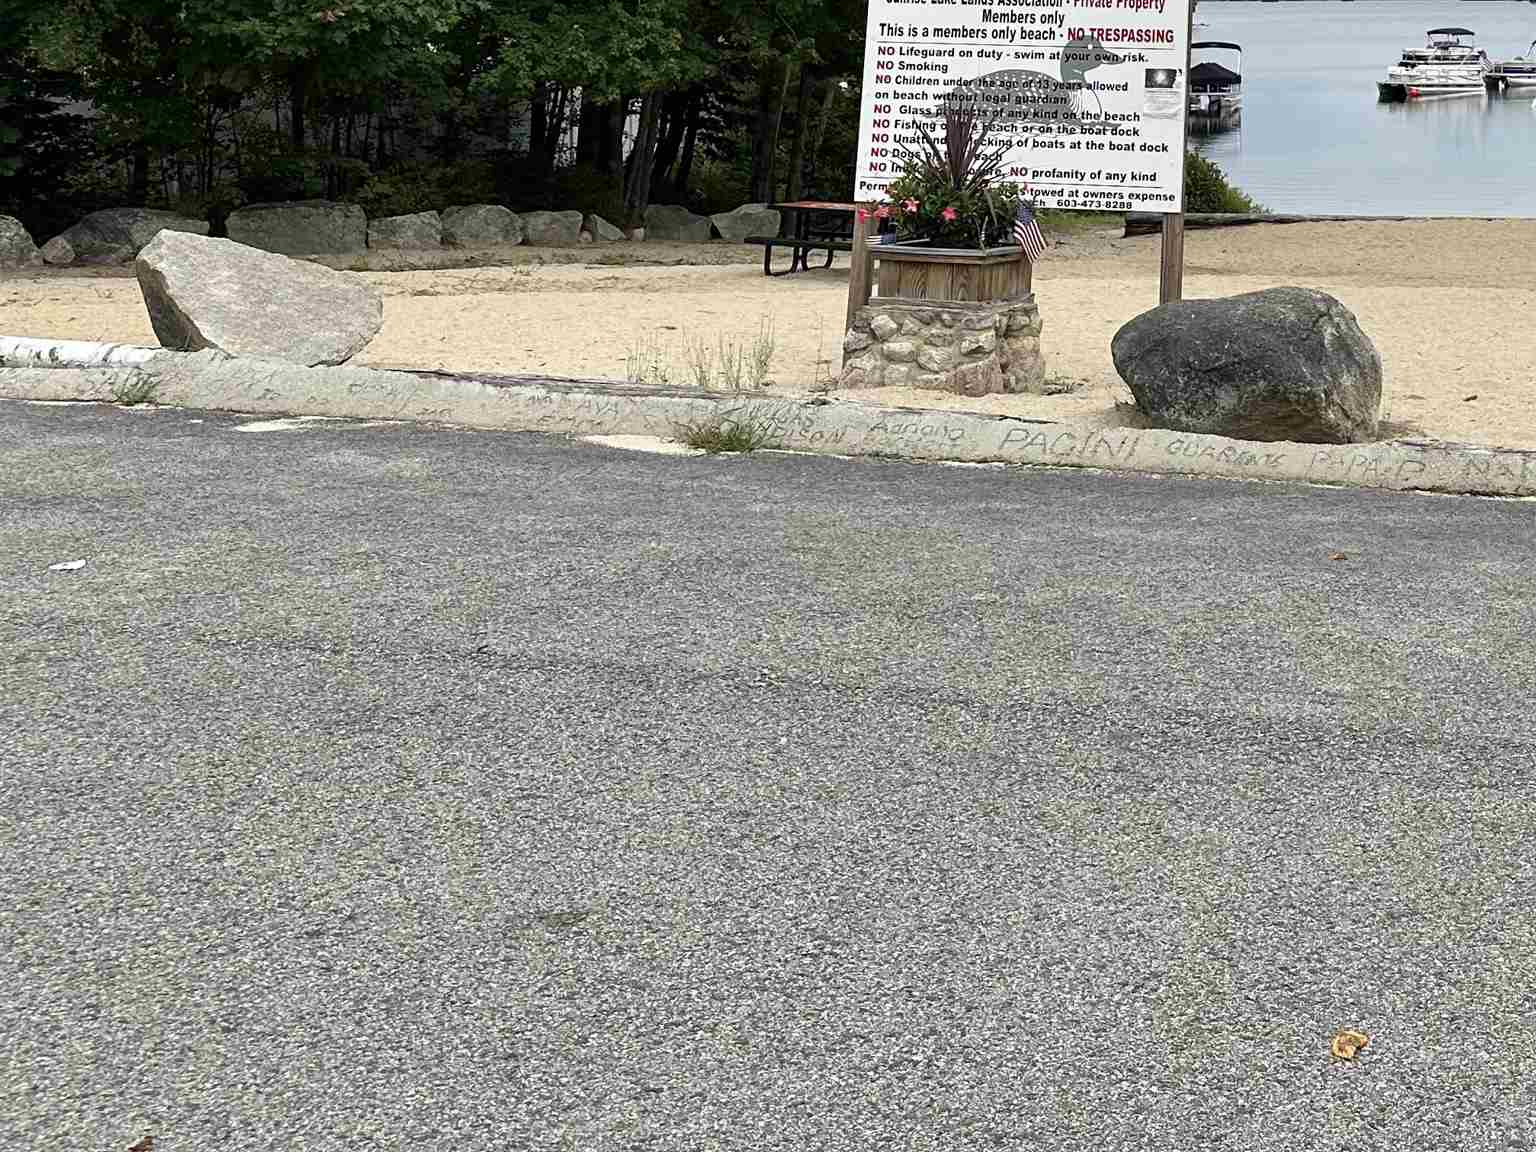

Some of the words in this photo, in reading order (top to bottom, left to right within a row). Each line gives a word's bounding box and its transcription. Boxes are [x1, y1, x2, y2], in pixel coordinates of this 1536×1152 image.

[982, 9, 1036, 24] Members
[1040, 10, 1065, 29] only
[879, 23, 904, 37] This
[908, 24, 918, 37] is
[922, 27, 929, 37] a
[933, 25, 988, 39] members
[991, 26, 1017, 43] only
[1020, 27, 1056, 42] beach
[1067, 28, 1085, 42] NO
[1089, 28, 1175, 44] TRESPASSING
[878, 46, 895, 56] NO
[899, 47, 955, 59] Lifeguard
[958, 50, 973, 58] on
[977, 49, 1003, 60] duty
[1014, 51, 1045, 61] swim
[1049, 51, 1060, 60] at
[1064, 53, 1091, 63] your
[1094, 53, 1119, 61] own
[876, 60, 894, 70] NO
[897, 61, 949, 74] Smoking
[875, 75, 891, 84] NO
[895, 75, 939, 86] Children
[943, 77, 972, 87] under
[979, 77, 995, 88] the
[1022, 79, 1034, 89] of
[1053, 82, 1082, 92] years
[1086, 80, 1128, 92] allowed
[874, 91, 889, 100] on
[893, 90, 928, 100] beach
[932, 91, 977, 101] without
[873, 104, 891, 114] NO
[899, 105, 932, 115] Glass
[991, 108, 1004, 117] of
[1007, 110, 1029, 121] any
[1033, 109, 1058, 120] kind
[1062, 112, 1077, 120] on
[1081, 111, 1101, 121] the
[1104, 111, 1140, 122] beach
[872, 119, 890, 129] NO
[1038, 125, 1053, 133] on
[1057, 124, 1076, 135] the
[1080, 125, 1106, 135] boat
[1110, 126, 1140, 137] dock
[871, 134, 889, 143] NO
[1016, 138, 1028, 147] of
[1032, 138, 1065, 149] boats
[1069, 140, 1082, 149] at
[1086, 140, 1105, 150] the
[1109, 141, 1135, 151] boat
[1139, 142, 1169, 152] dock
[870, 148, 887, 157] NO
[892, 149, 921, 160] Dogs
[868, 163, 887, 172] NO
[1010, 168, 1028, 177] NO
[1032, 168, 1086, 181] profanity
[1090, 171, 1102, 180] of
[1105, 173, 1127, 182] any
[1131, 172, 1157, 182] kind
[1031, 189, 1064, 198] towed
[1068, 189, 1079, 198] at
[1083, 191, 1124, 200] owners
[1128, 193, 1176, 202] expense
